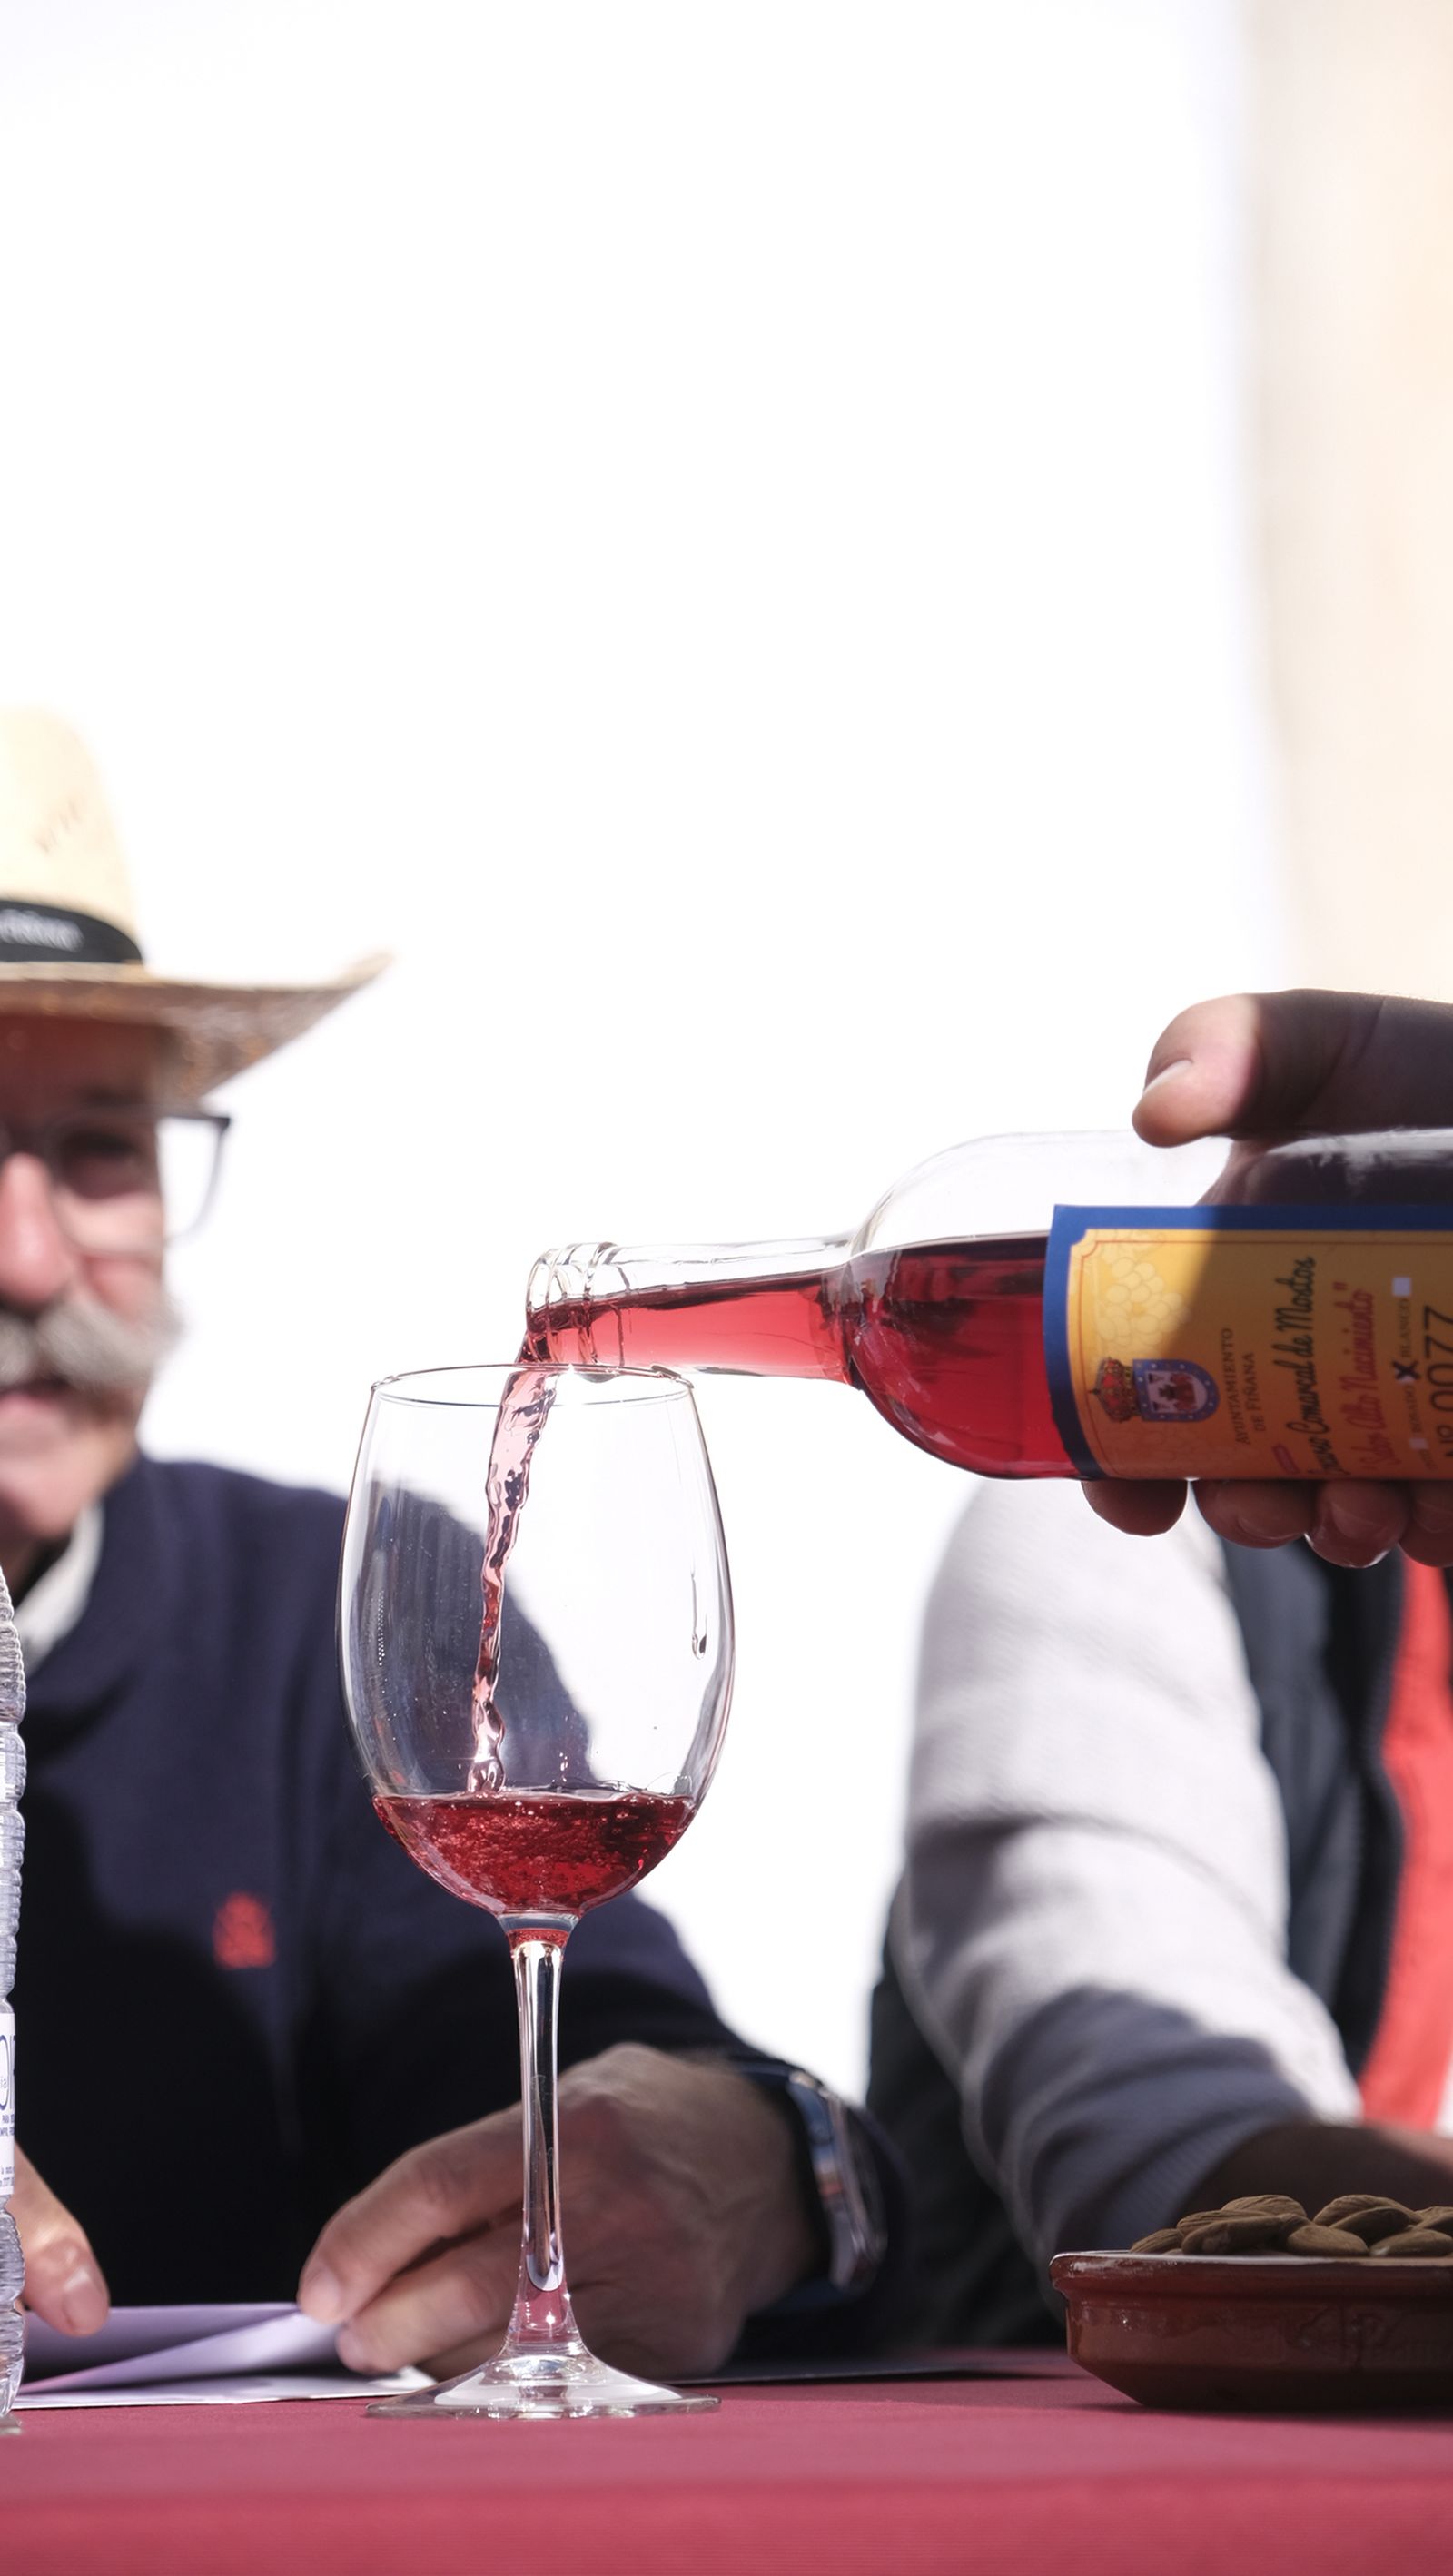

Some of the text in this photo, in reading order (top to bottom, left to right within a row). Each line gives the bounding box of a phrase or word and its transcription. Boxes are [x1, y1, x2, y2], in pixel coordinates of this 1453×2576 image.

[1274, 1256, 1316, 1332] Mostos
[1241, 1352, 1263, 1412] FIÑANA
[1271, 1335, 1314, 1358] de
[1422, 1304, 1453, 1413] 0077
[1221, 1327, 1251, 1445] AYUNTAMIENTO
[1272, 1358, 1331, 1435] Comarcal
